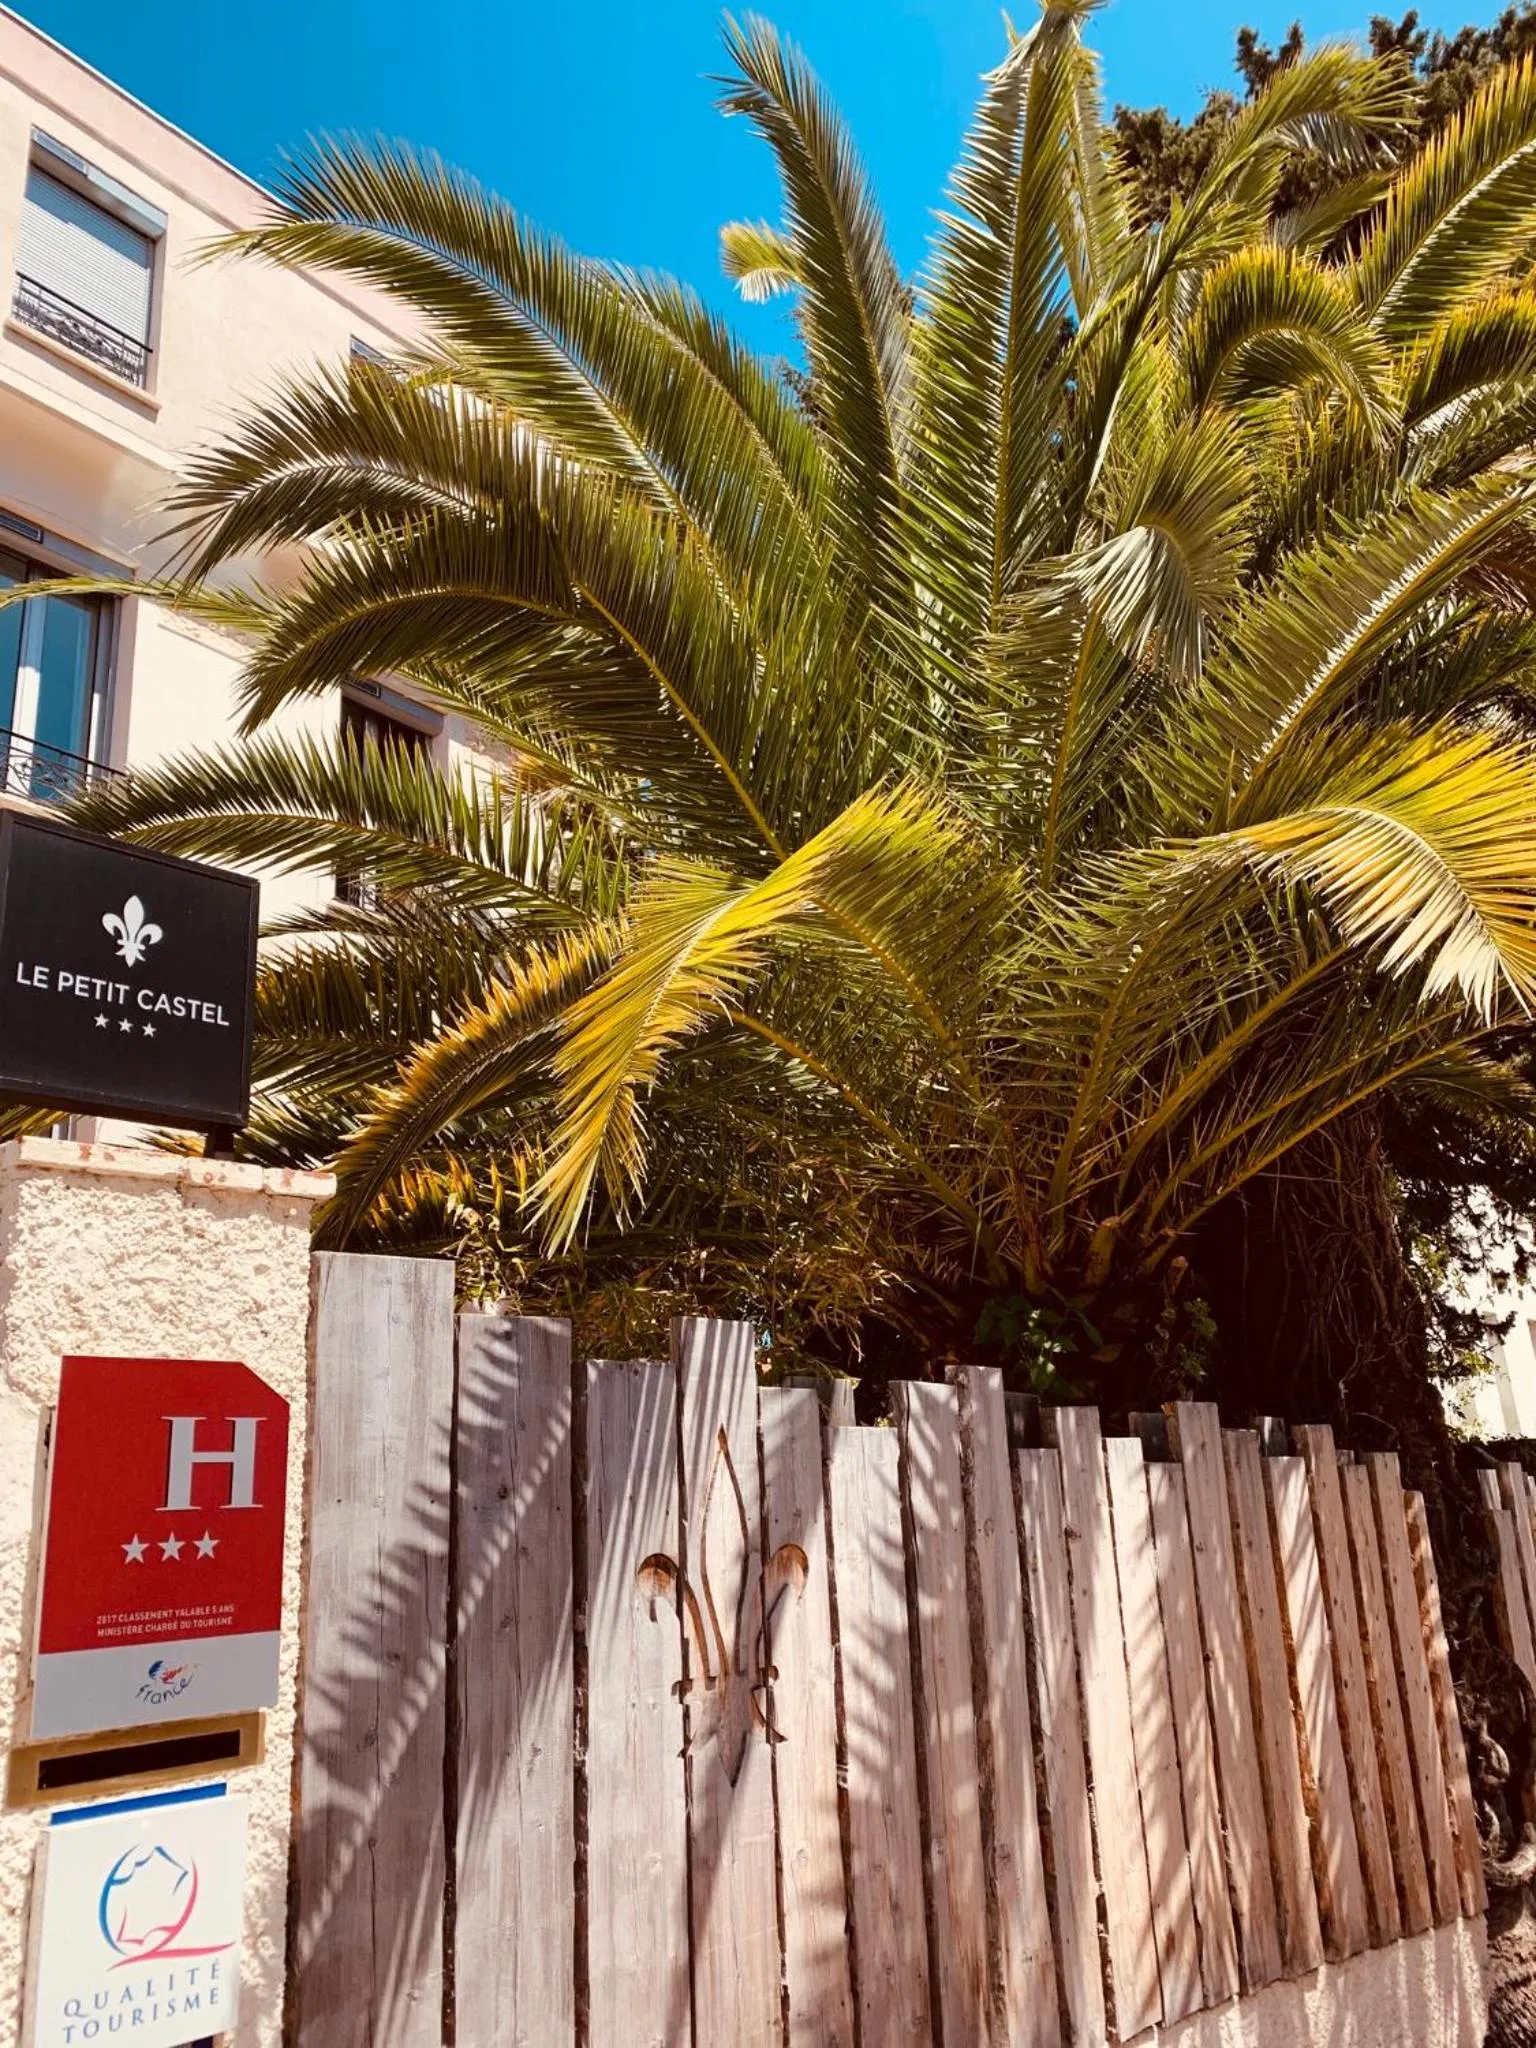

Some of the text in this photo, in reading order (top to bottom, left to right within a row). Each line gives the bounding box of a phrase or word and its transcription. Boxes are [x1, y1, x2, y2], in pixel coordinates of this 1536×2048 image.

[16, 962, 230, 1026] LE PETIT CASTEL
[155, 1415, 268, 1511] H
[118, 1609, 174, 1623] CLASSEMENT
[175, 1606, 210, 1618] VALABLE
[218, 1604, 234, 1613] ANS
[179, 1620, 191, 1630] DU
[193, 1616, 232, 1628] TOURISME
[61, 1988, 220, 2044] TOURISME
[63, 1959, 221, 2018] QUALITÉ
